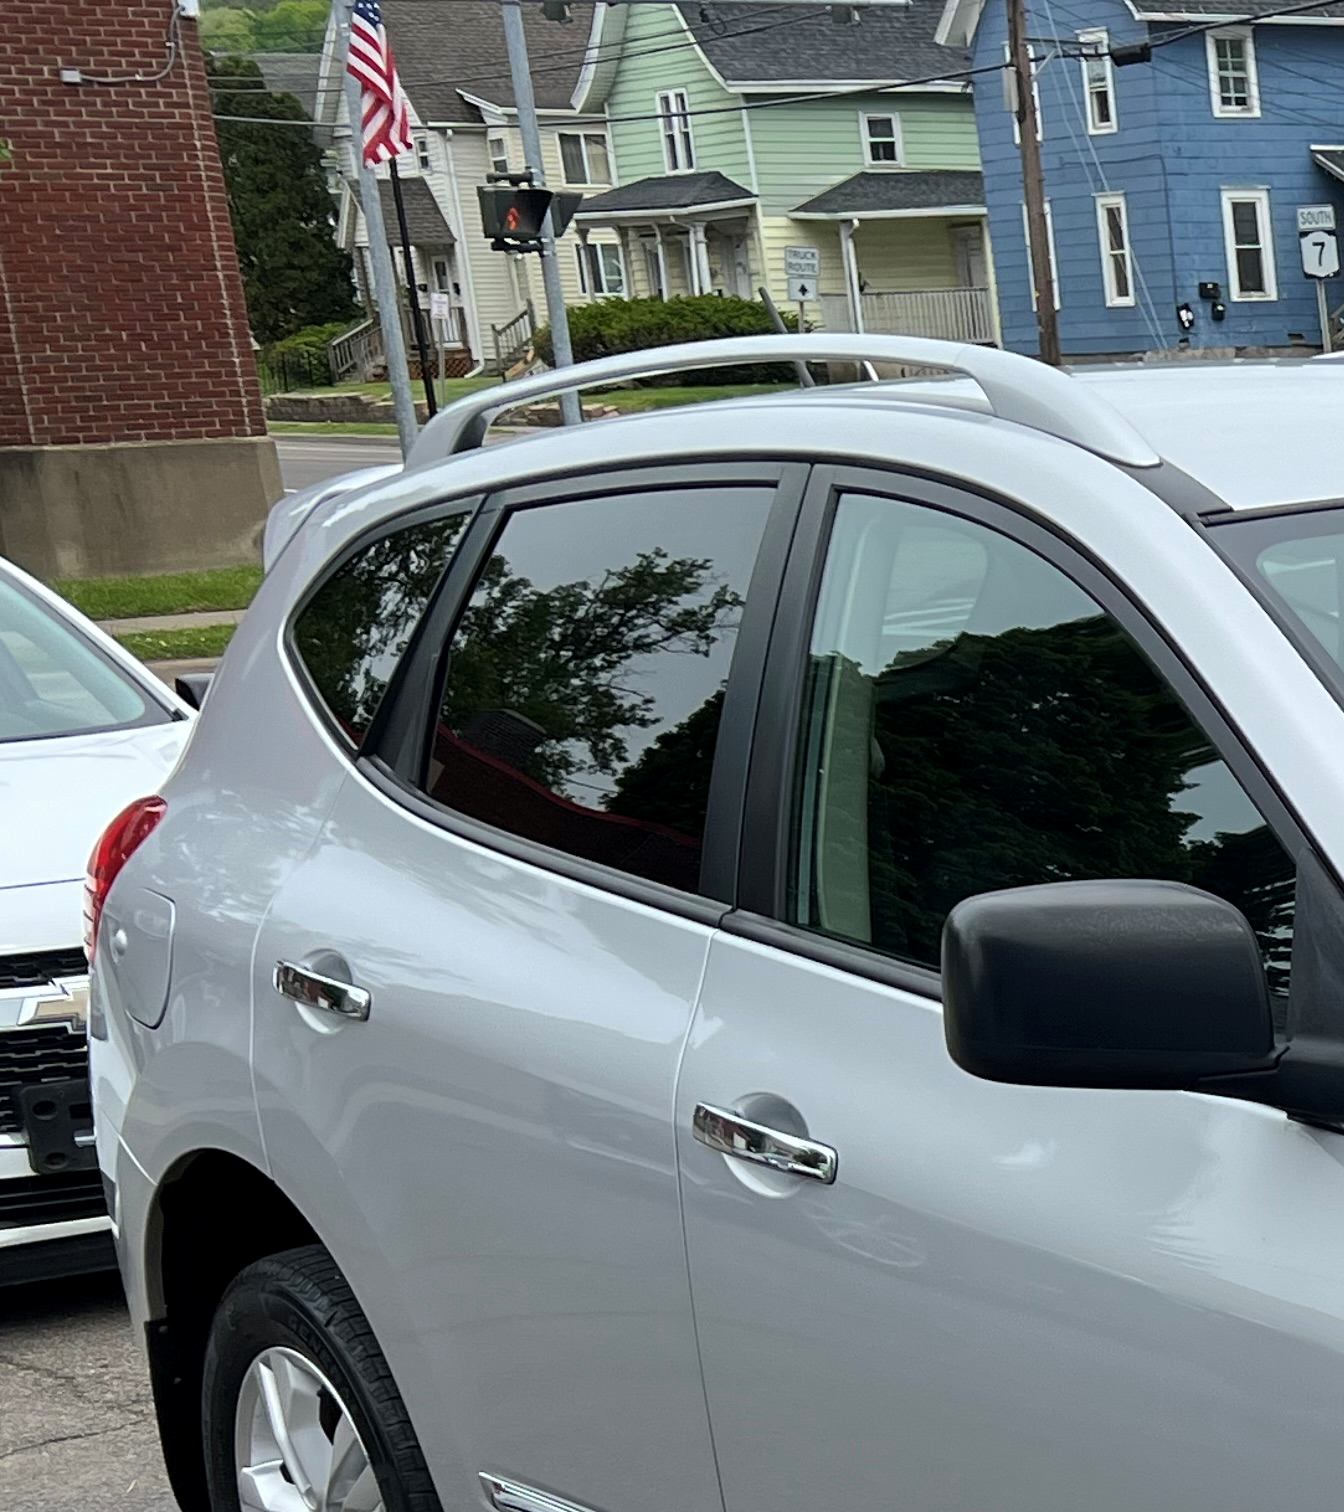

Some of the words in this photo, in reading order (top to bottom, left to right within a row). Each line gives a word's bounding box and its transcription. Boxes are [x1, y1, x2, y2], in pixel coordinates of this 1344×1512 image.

[1300, 210, 1332, 225] SOUTH
[787, 249, 816, 260] TRUCK
[1312, 241, 1325, 267] 7
[787, 262, 817, 273] ROUTE
